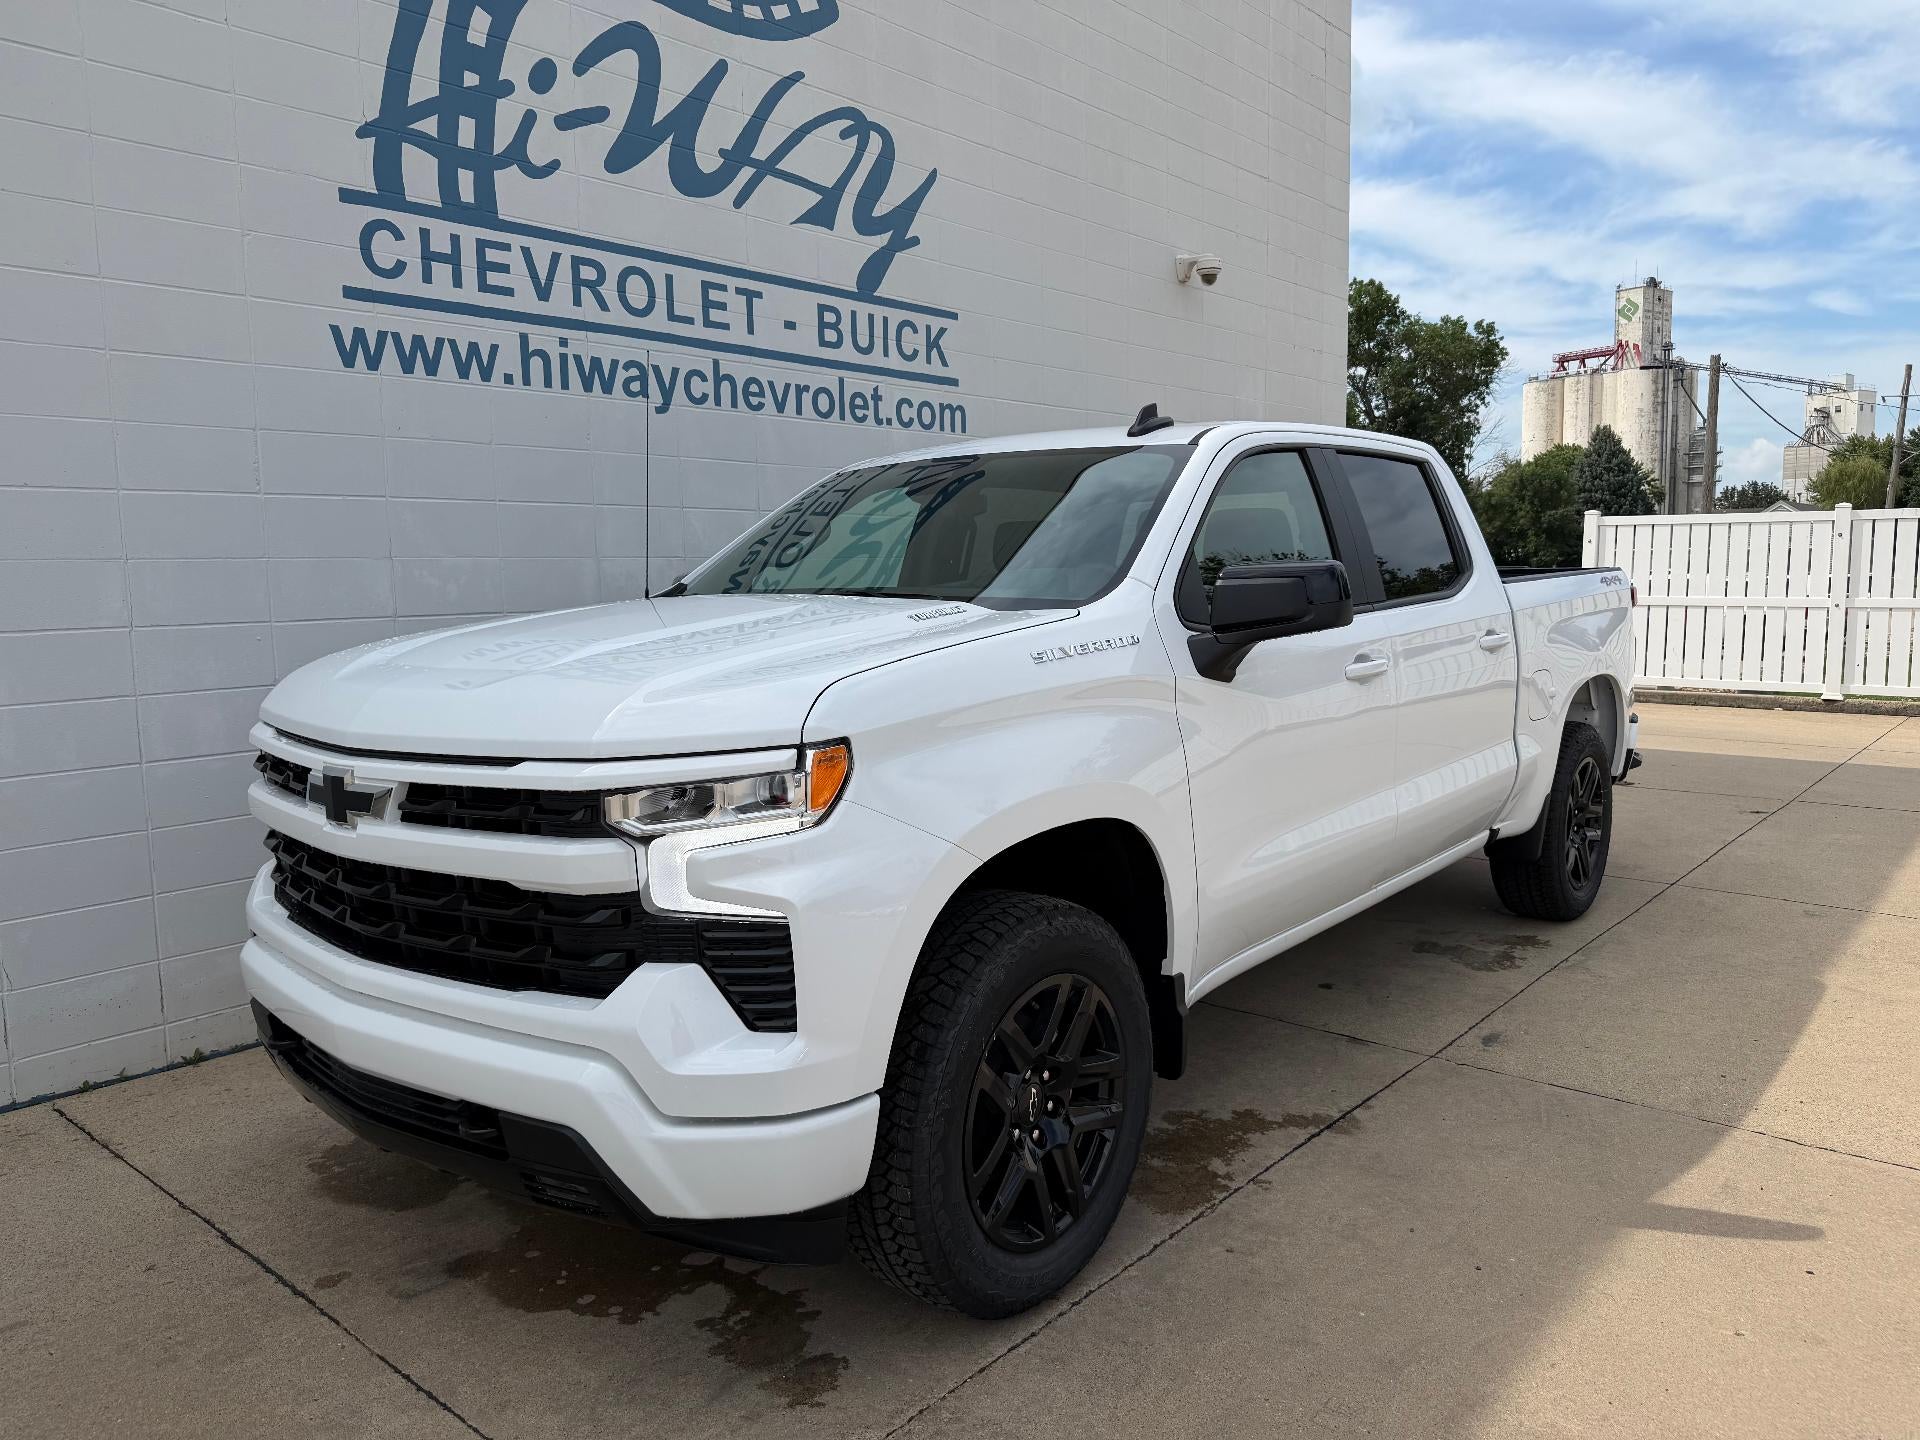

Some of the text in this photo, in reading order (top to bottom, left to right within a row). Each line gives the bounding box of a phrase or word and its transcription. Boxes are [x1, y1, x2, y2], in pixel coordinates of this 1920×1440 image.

[357, 217, 765, 337] CHEVROLET
[816, 303, 951, 369] BUICK
[328, 324, 968, 434] www.hiwaychevrolet.com
[1029, 633, 1141, 665] SILVERADO
